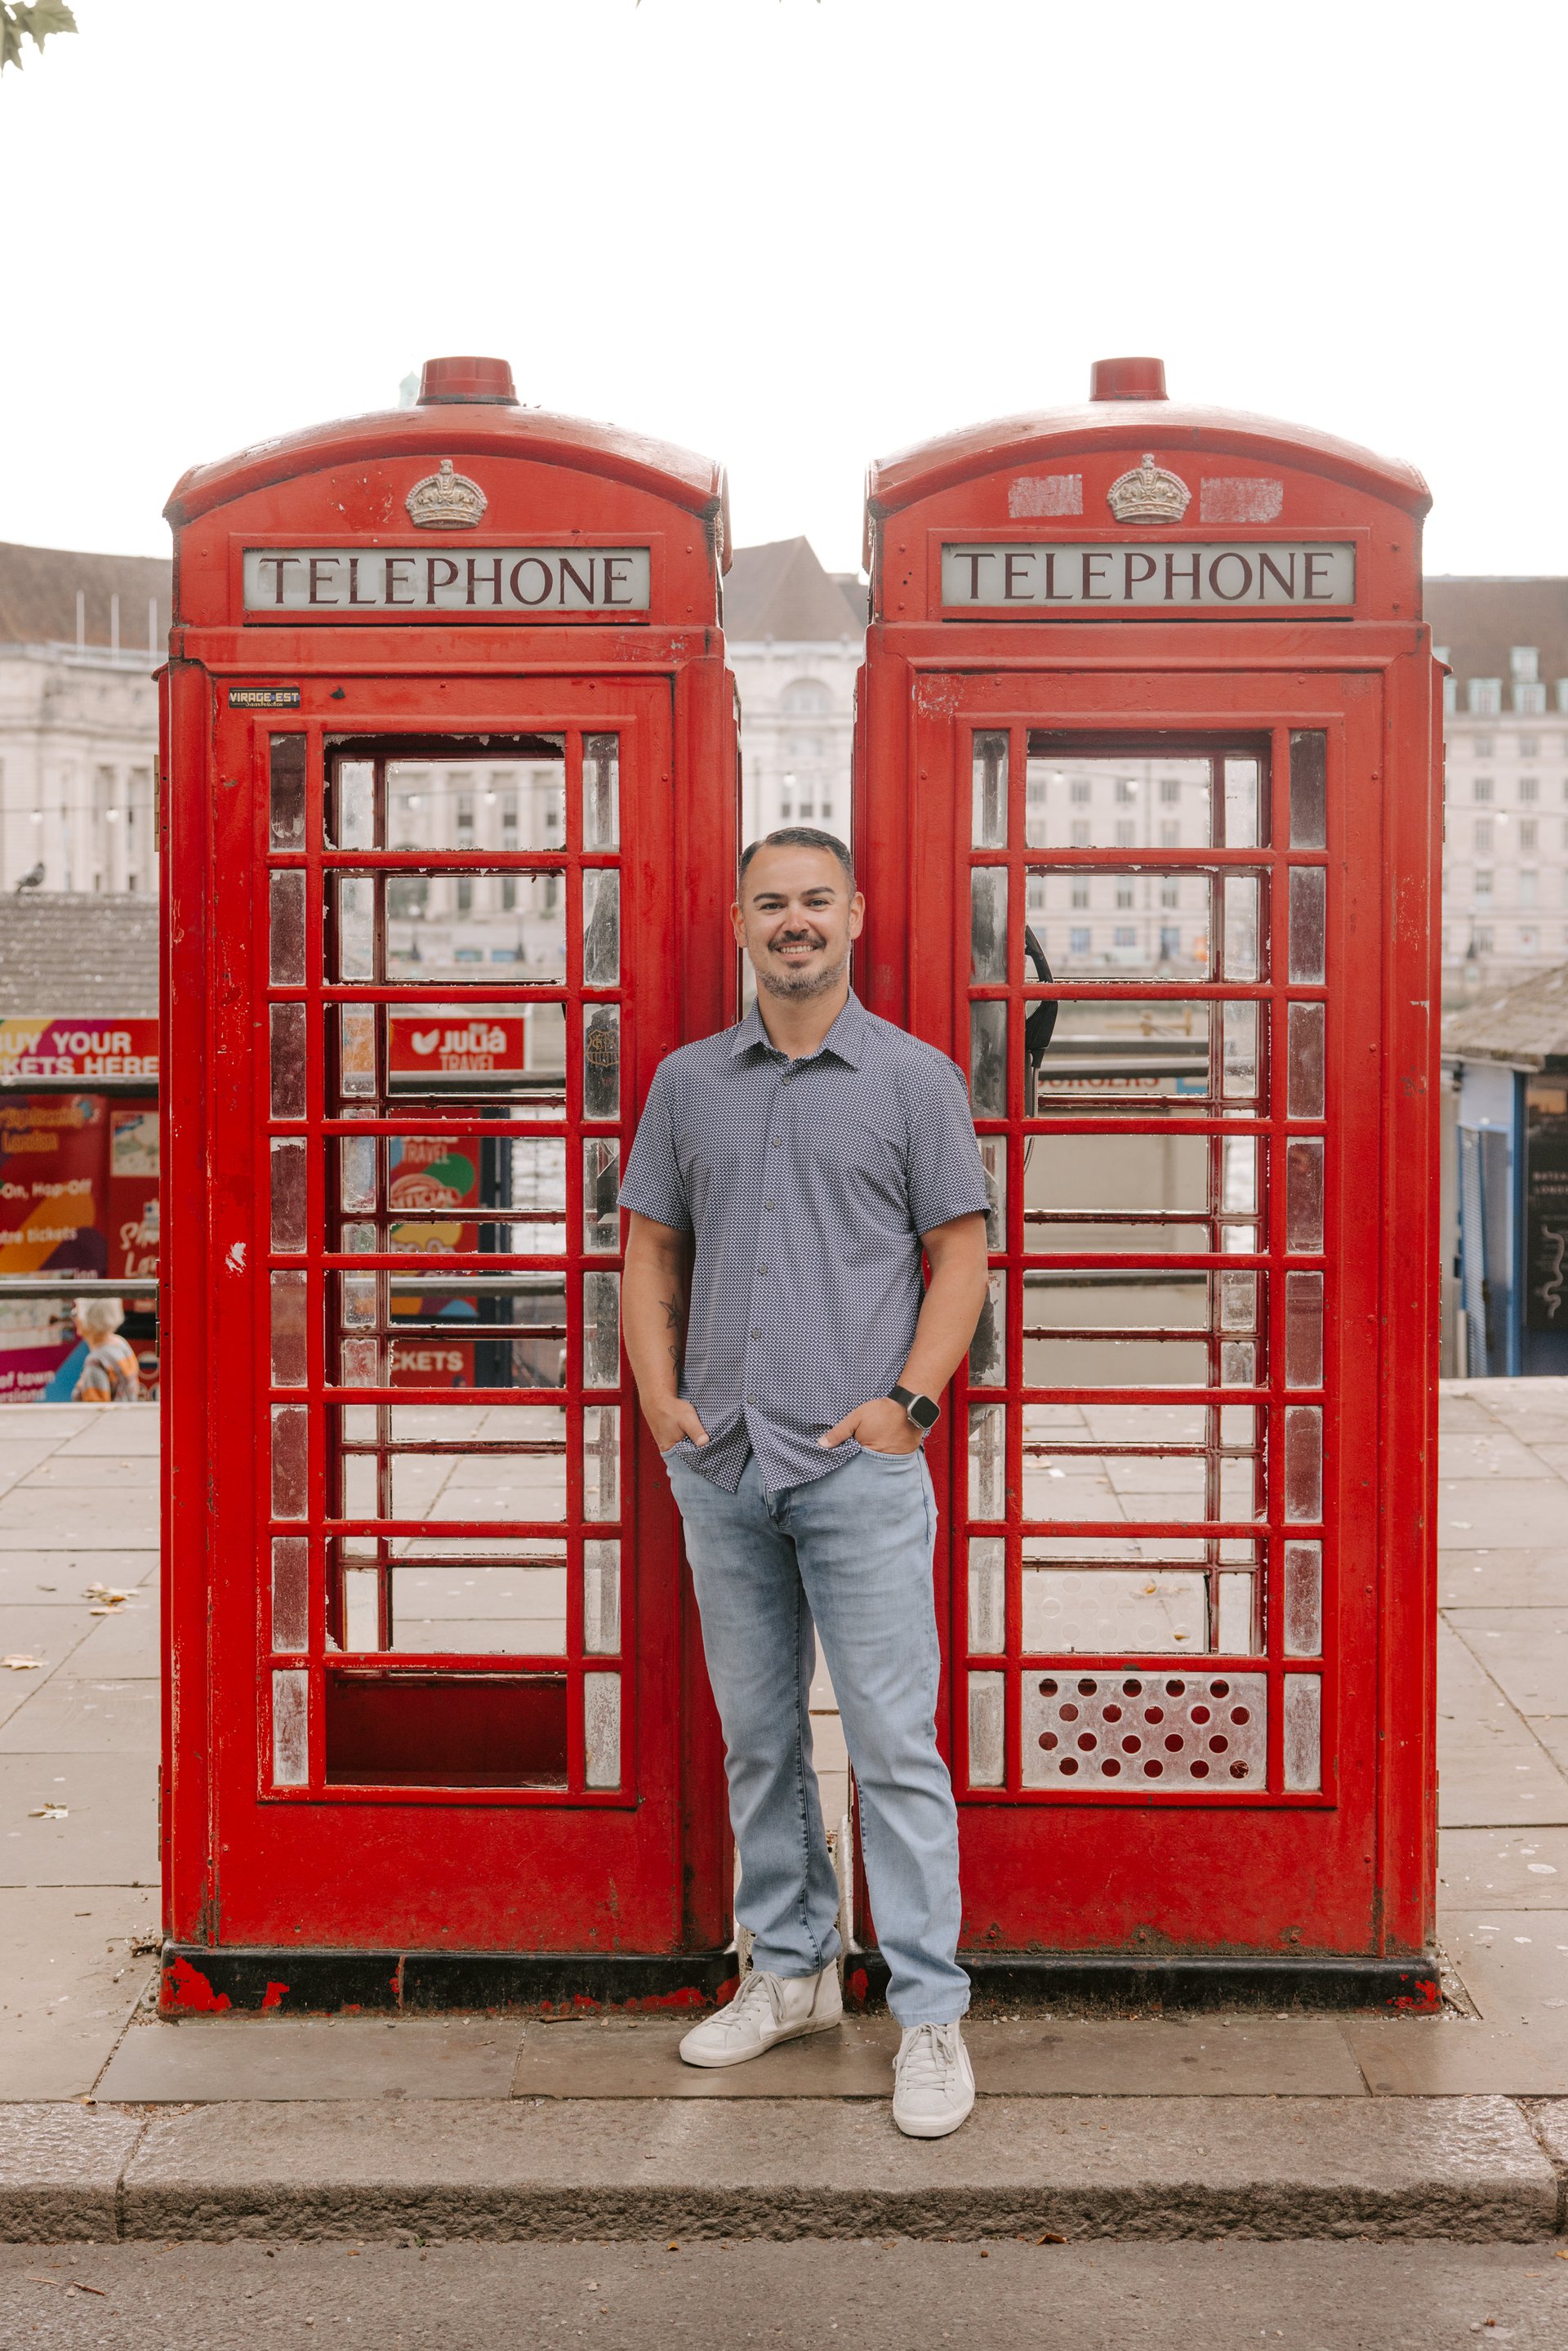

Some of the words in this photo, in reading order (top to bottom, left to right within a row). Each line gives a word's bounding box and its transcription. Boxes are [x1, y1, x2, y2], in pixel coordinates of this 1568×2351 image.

[259, 558, 634, 605] TELEPHONE
[954, 552, 1334, 600] TELEPHONE
[229, 692, 271, 703] VIRAGE
[51, 1031, 132, 1055] YOUR
[0, 1056, 76, 1075] KETS
[83, 1056, 159, 1075] HERE
[0, 1182, 29, 1201] On,
